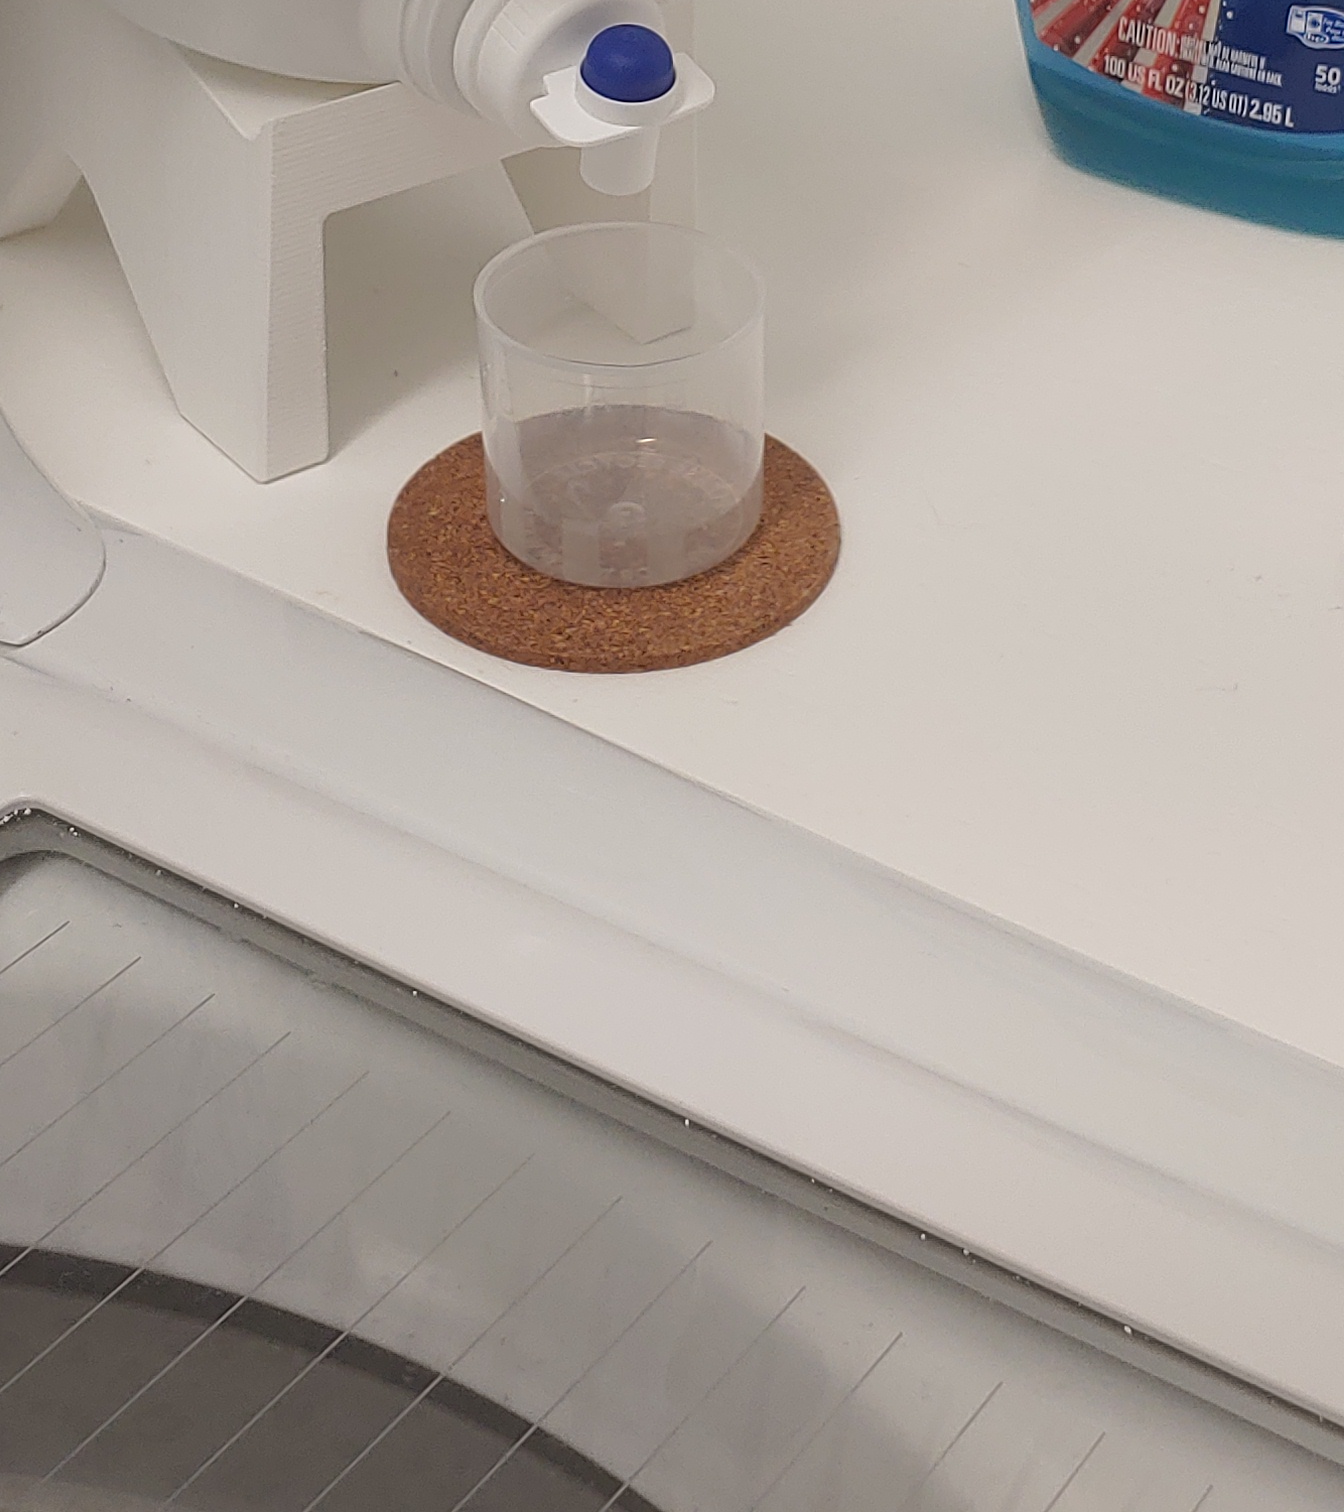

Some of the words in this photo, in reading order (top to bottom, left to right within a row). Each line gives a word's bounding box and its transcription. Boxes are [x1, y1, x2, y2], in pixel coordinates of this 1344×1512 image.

[1118, 16, 1180, 58] CAUTION:
[1104, 54, 1125, 77] 100
[1128, 62, 1145, 82] US
[1148, 70, 1163, 89] FL
[1166, 75, 1184, 98] OZ
[1212, 90, 1227, 110] US
[1249, 99, 1282, 125] 2.95
[1284, 107, 1294, 128] L
[1315, 64, 1341, 85] 50
